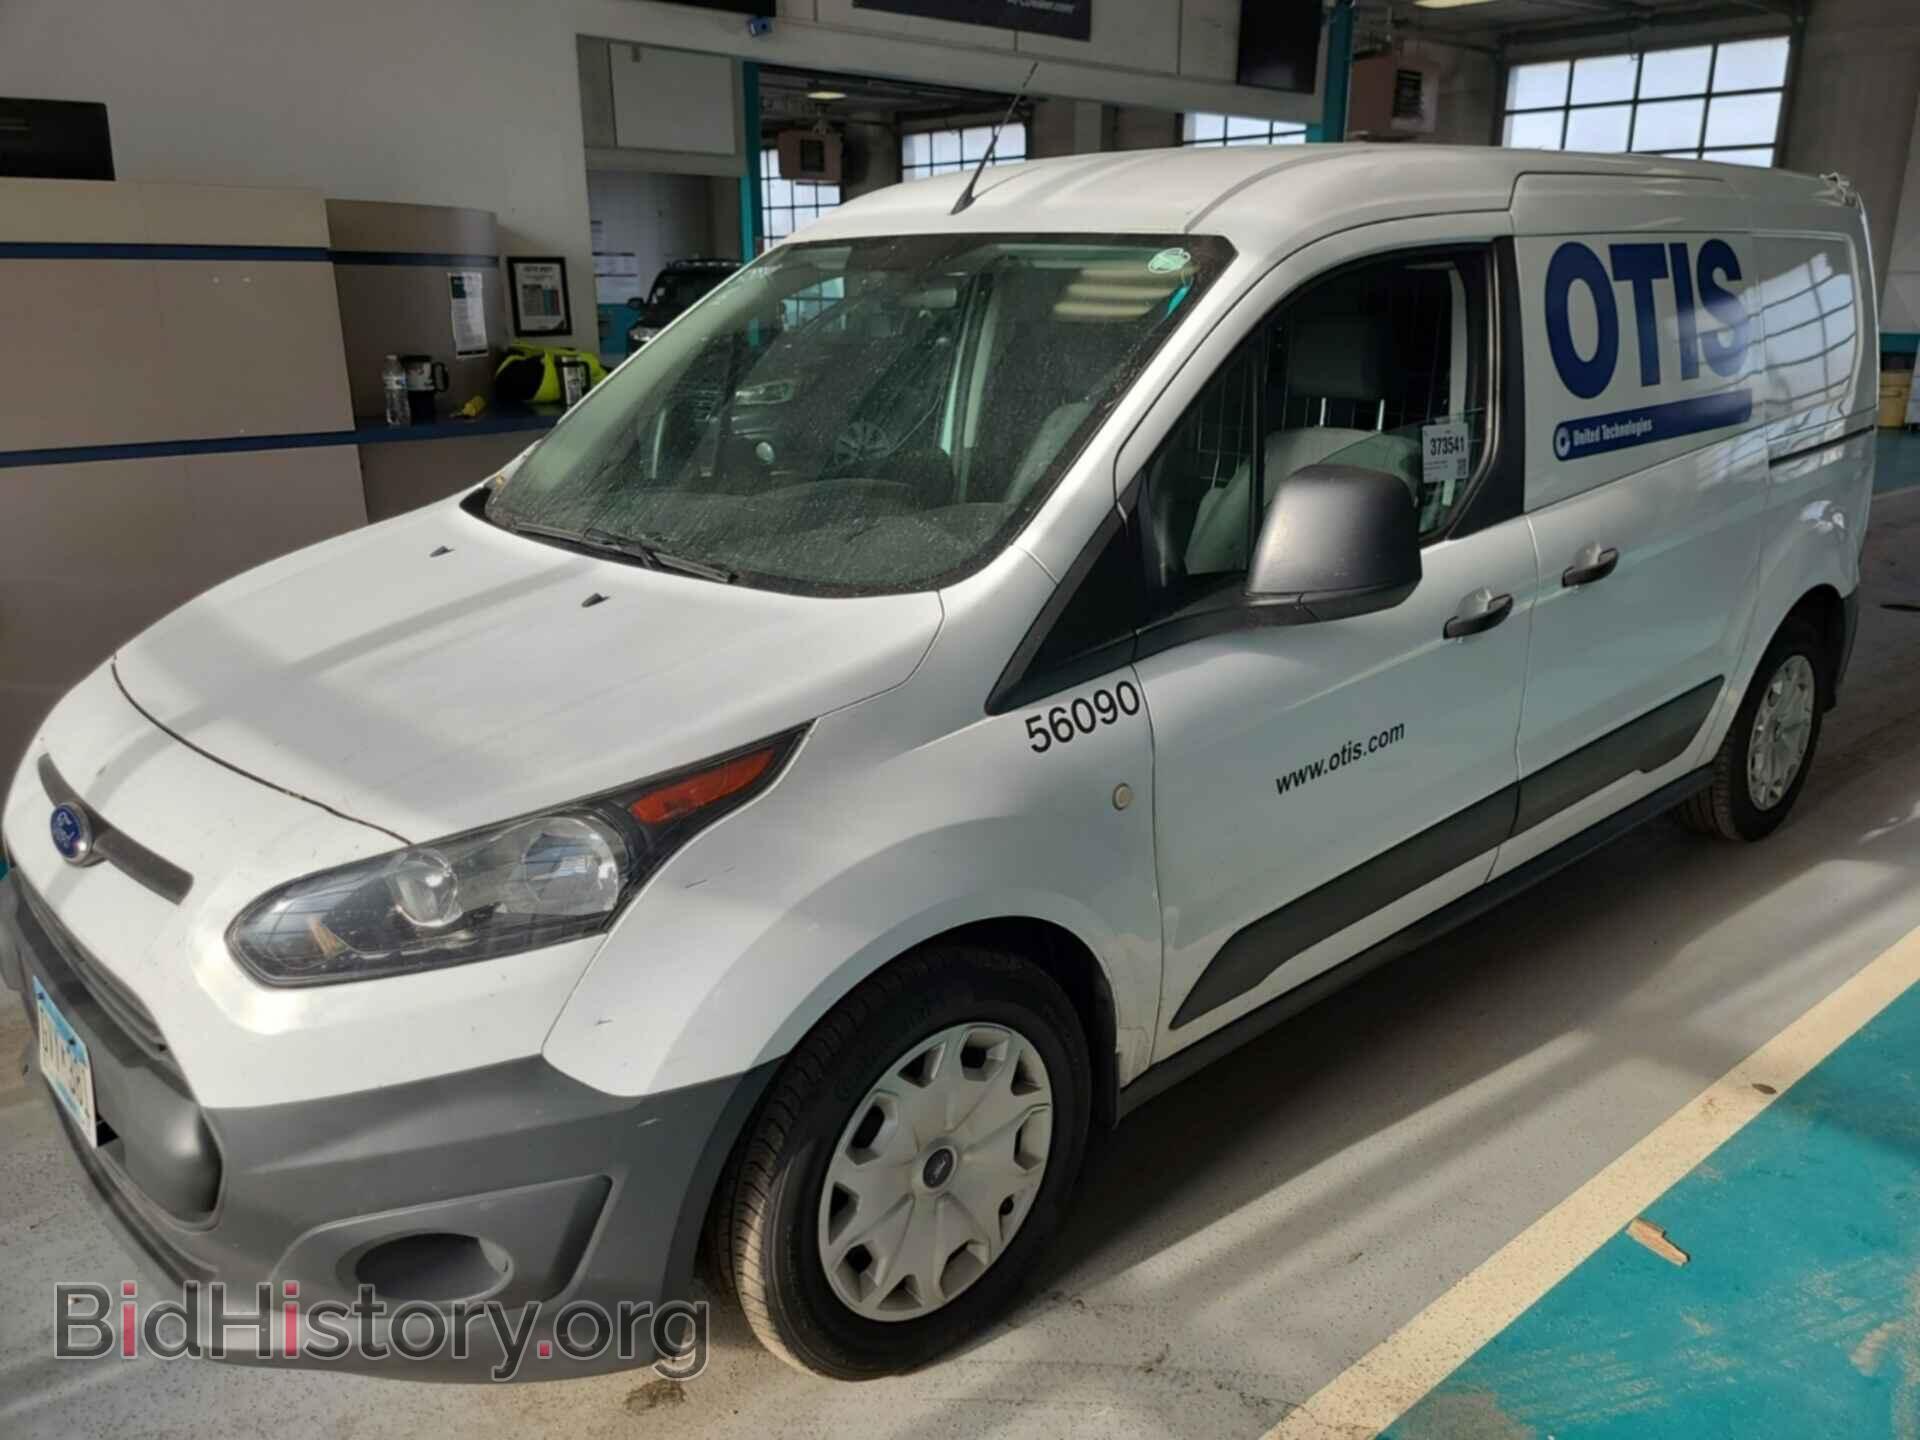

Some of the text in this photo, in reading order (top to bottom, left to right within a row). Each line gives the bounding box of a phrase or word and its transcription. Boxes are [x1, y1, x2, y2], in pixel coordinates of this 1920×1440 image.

[1544, 238, 1749, 399] OTIS
[1430, 436, 1464, 455] 373541
[1573, 417, 1653, 446] United Technologies
[1025, 680, 1139, 753] 56090
[1276, 723, 1404, 795] www.otis.com
